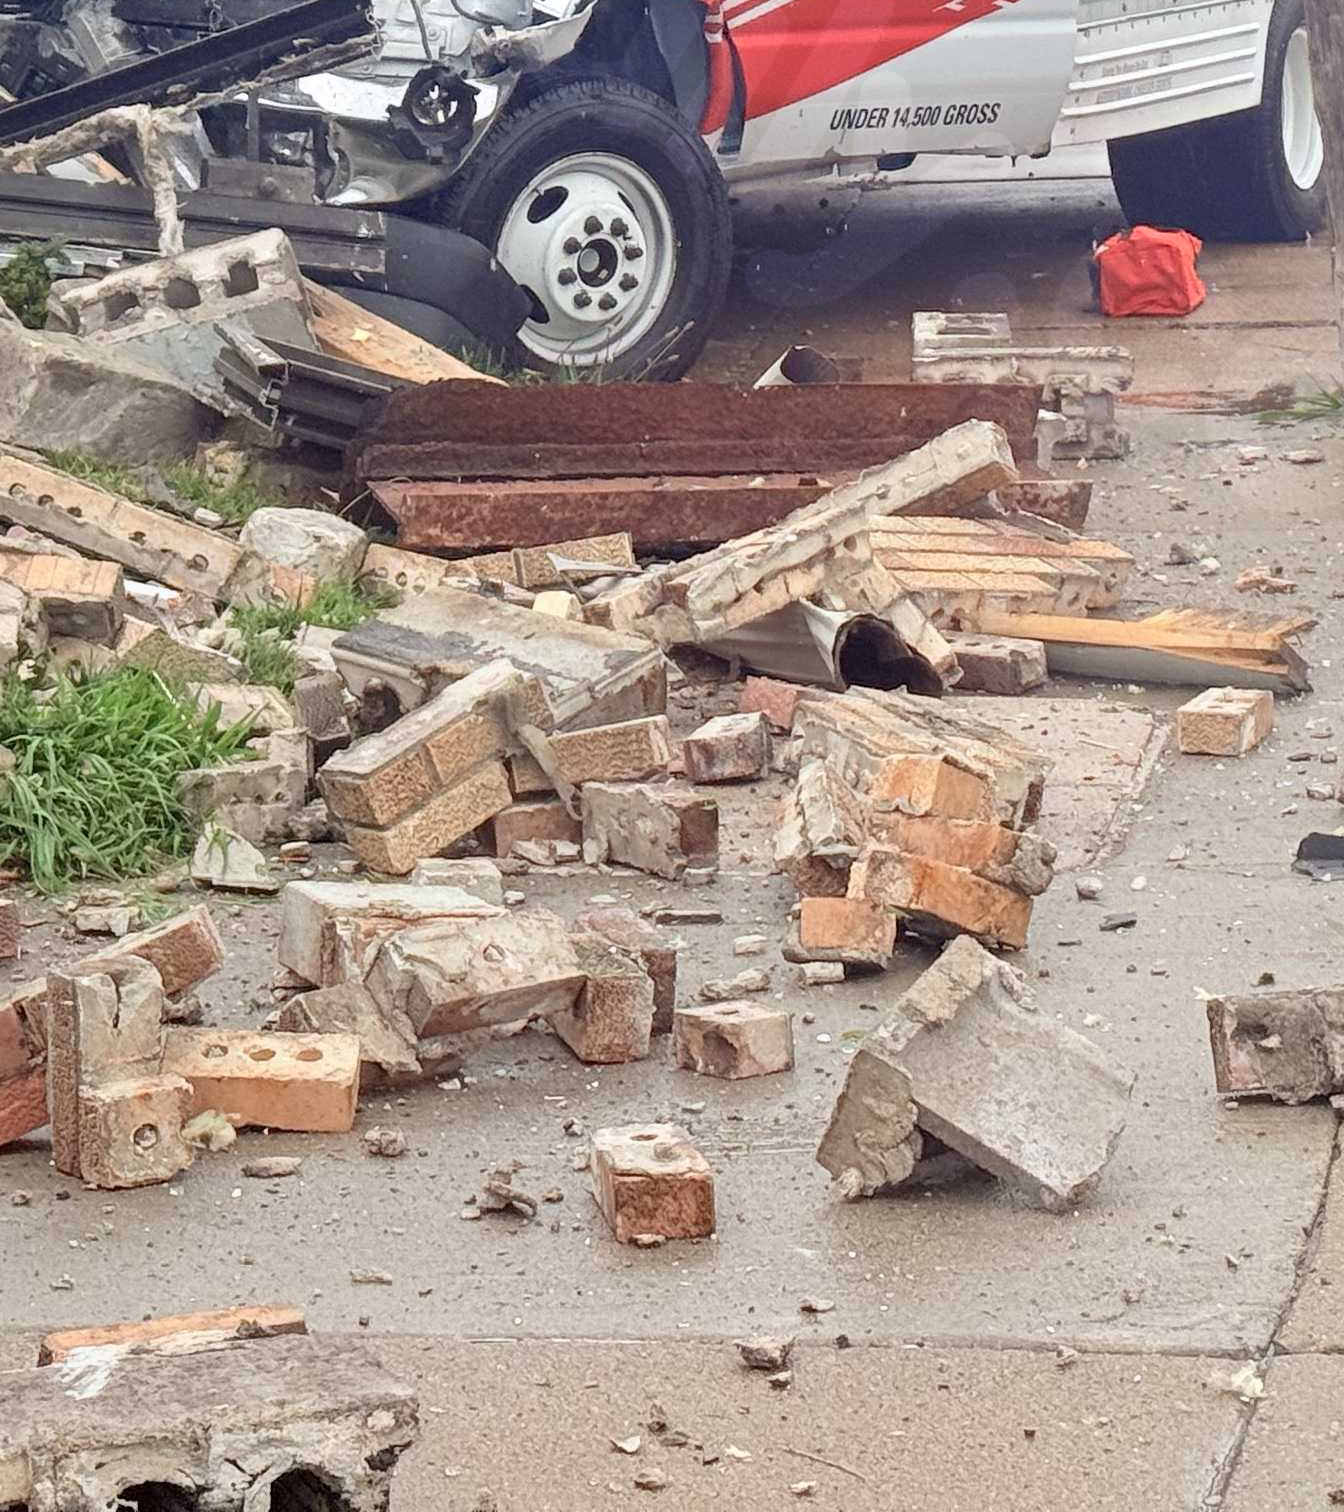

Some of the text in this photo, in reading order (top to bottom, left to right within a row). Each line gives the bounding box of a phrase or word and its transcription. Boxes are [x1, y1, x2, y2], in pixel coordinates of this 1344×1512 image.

[830, 103, 1001, 130] UNDER 14,500 GROSS
